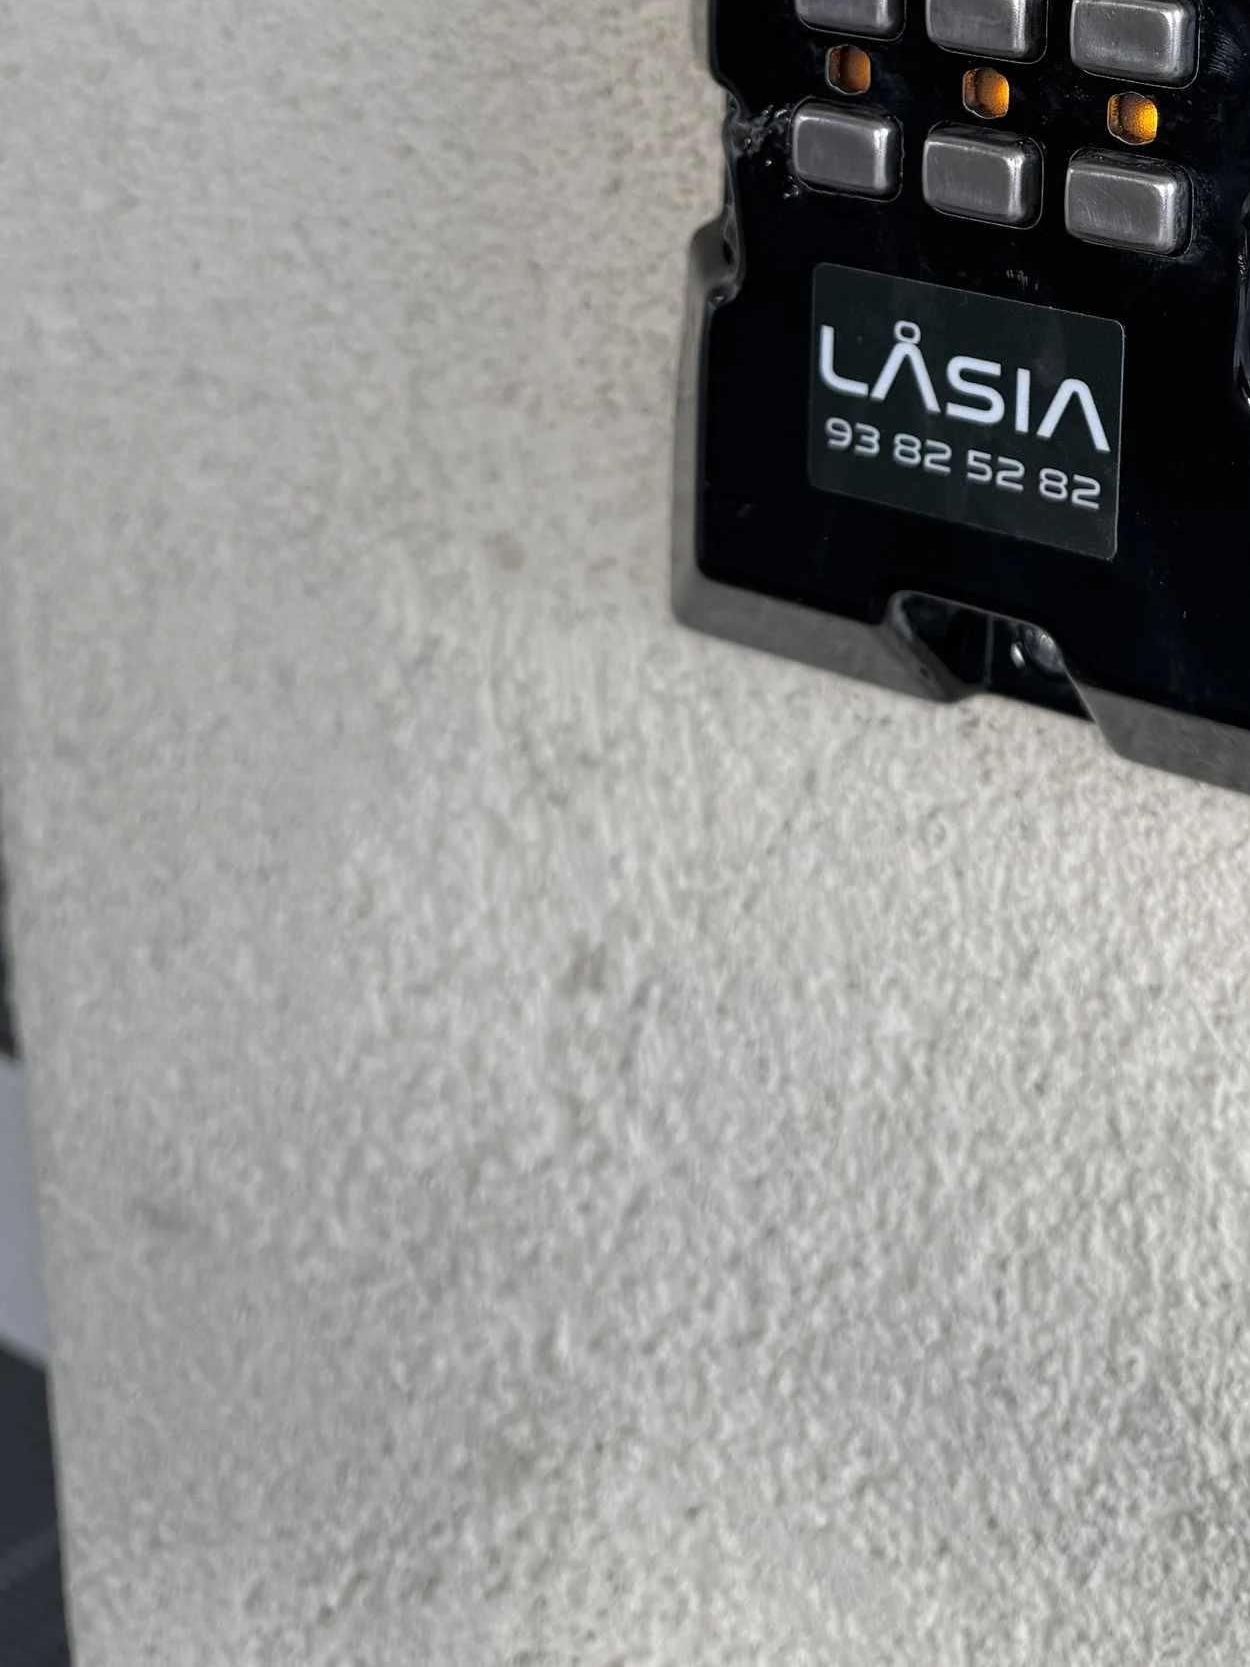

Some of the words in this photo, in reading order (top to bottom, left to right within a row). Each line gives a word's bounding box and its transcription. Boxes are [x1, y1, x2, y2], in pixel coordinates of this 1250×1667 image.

[819, 320, 1111, 453] LÅSIA
[825, 417, 881, 456] 93
[893, 433, 953, 474] 82
[966, 449, 1026, 492] 52
[1038, 467, 1101, 510] 82
